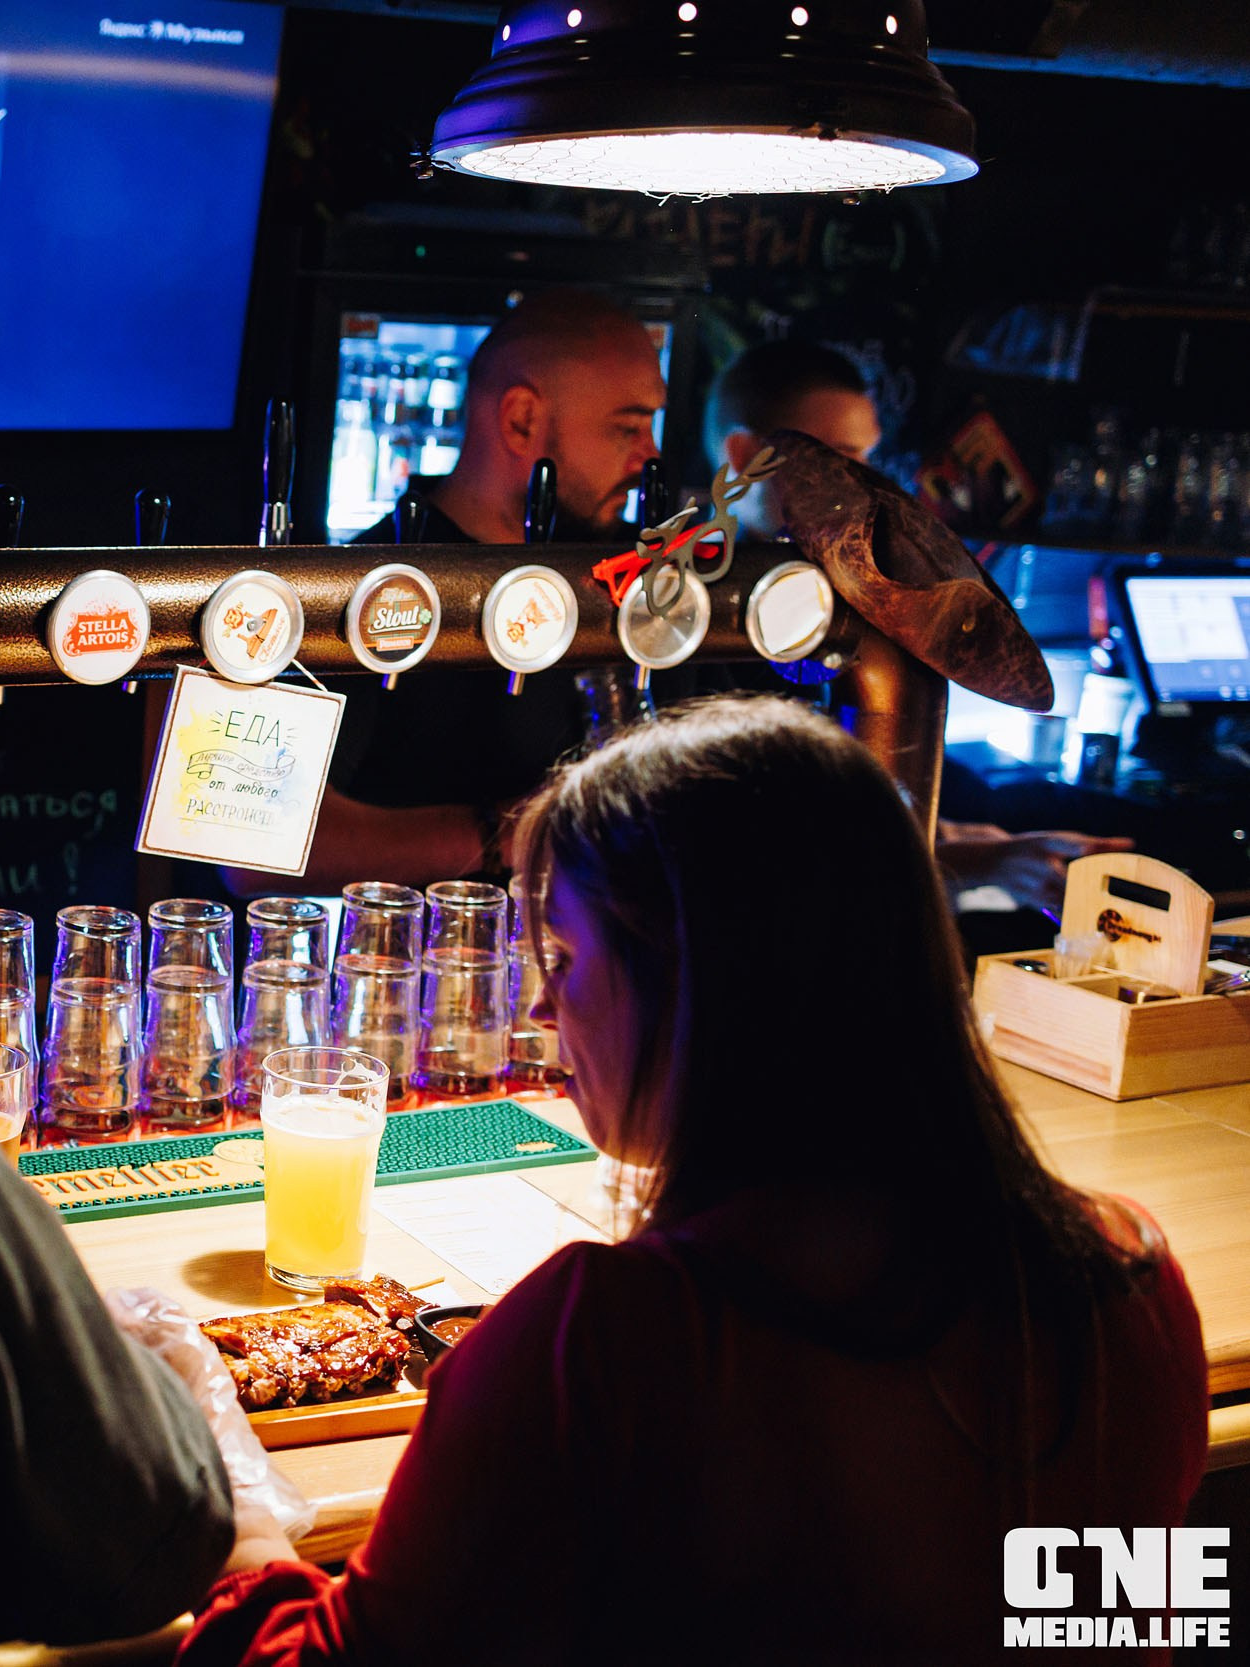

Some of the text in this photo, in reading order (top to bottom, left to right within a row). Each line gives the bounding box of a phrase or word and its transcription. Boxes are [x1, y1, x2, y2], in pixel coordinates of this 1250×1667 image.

[78, 619, 128, 633] STELLA
[373, 605, 419, 630] Stout
[77, 632, 129, 646] ARTOIS
[225, 710, 280, 747] ЕДА
[209, 780, 279, 798] от любого
